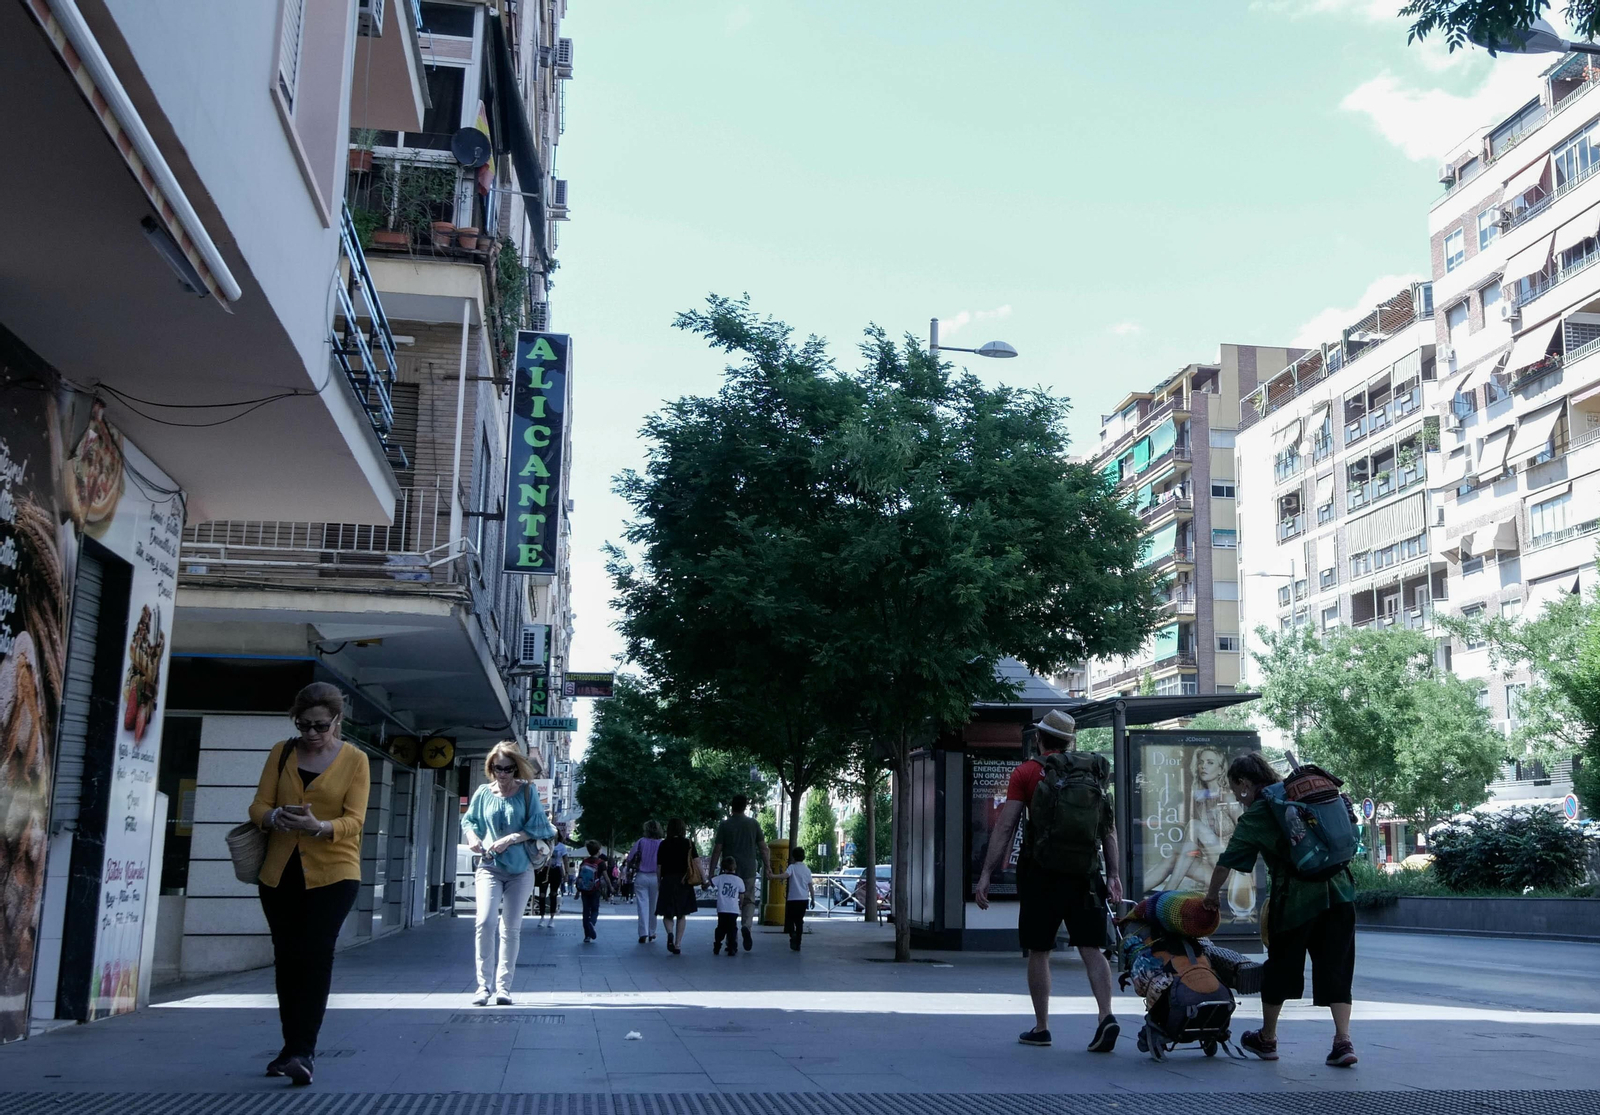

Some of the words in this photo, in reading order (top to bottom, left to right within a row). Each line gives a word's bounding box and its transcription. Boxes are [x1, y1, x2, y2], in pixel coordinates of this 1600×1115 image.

[517, 338, 557, 567] ALICANTE
[533, 719, 573, 727] ALICANTE
[1152, 751, 1182, 766] Dior
